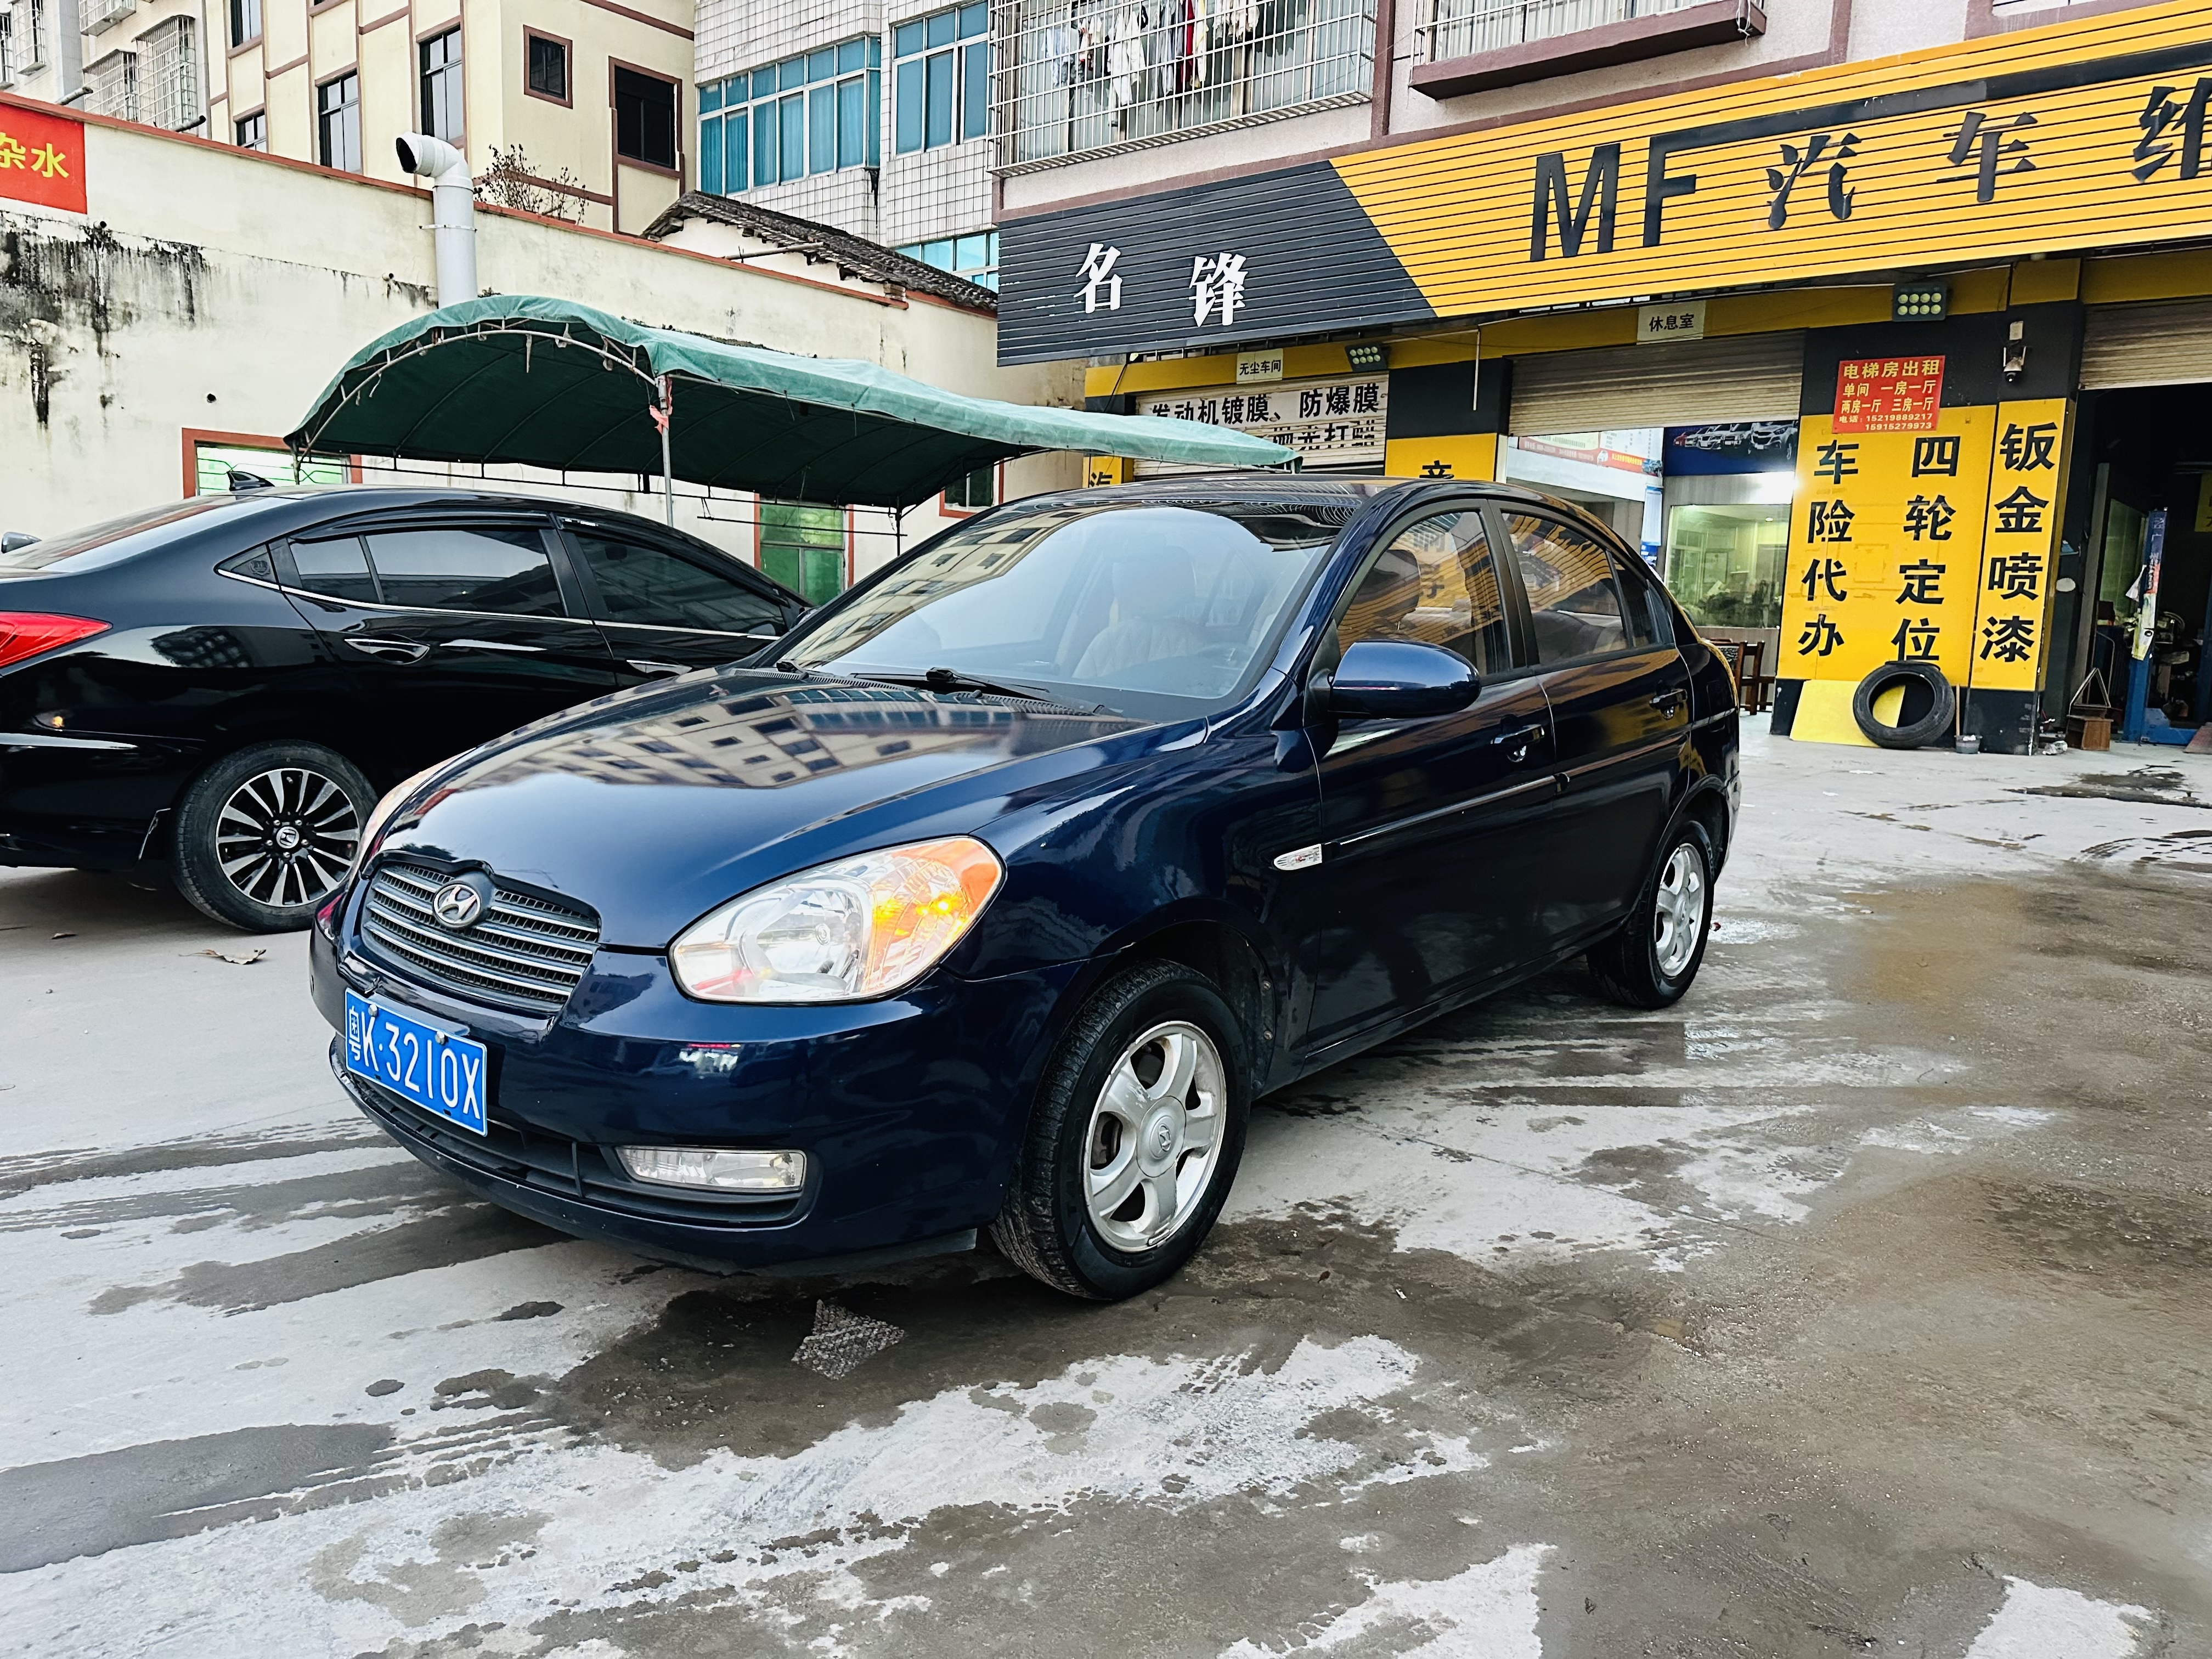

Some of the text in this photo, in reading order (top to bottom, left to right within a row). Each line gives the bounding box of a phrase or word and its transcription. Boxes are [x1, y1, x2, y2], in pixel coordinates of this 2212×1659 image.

[1530, 135, 1697, 262] MF
[1073, 242, 1249, 328] 名锋
[1649, 313, 1695, 332] 休息室
[1239, 359, 1282, 376] 无尘车间
[1843, 359, 1940, 379] 电梯房出租
[1842, 380, 1937, 398] 单间 一房一厅
[1841, 397, 1934, 414] 两房一厅 三房一厅
[1865, 422, 1932, 431] 15915279973
[1798, 439, 1859, 657] 车险代办
[1891, 436, 1961, 662] 四轮定位
[1979, 422, 2058, 662] 钣金喷漆
